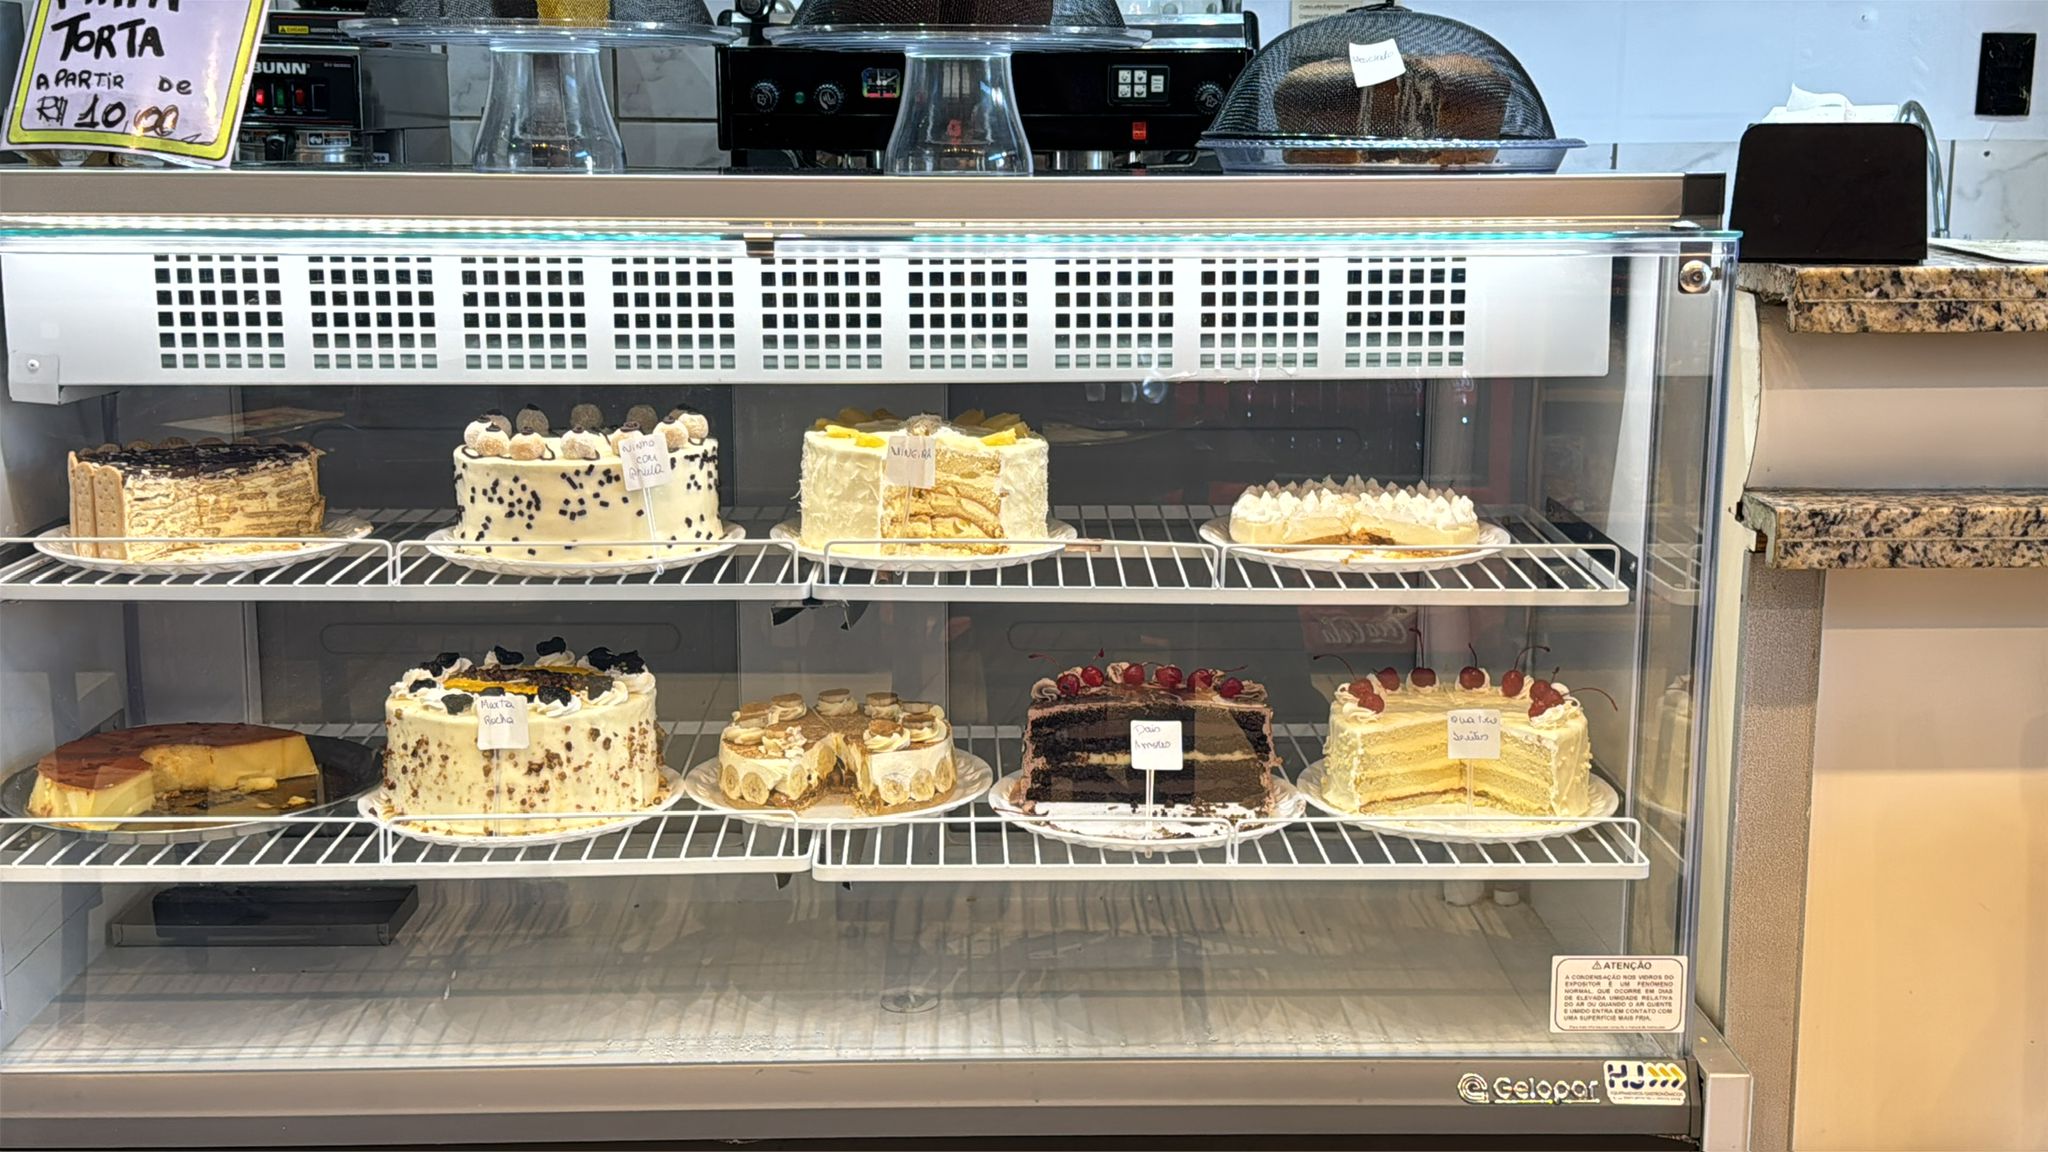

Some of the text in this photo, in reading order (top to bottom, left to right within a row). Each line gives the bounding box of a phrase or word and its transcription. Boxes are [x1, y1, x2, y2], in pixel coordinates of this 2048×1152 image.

[51, 12, 165, 61] TORTA
[253, 61, 307, 75] BUNN
[36, 73, 49, 90] A
[1603, 961, 1652, 970] ATENÇÃO
[1493, 1077, 1599, 1104] Gelopar
